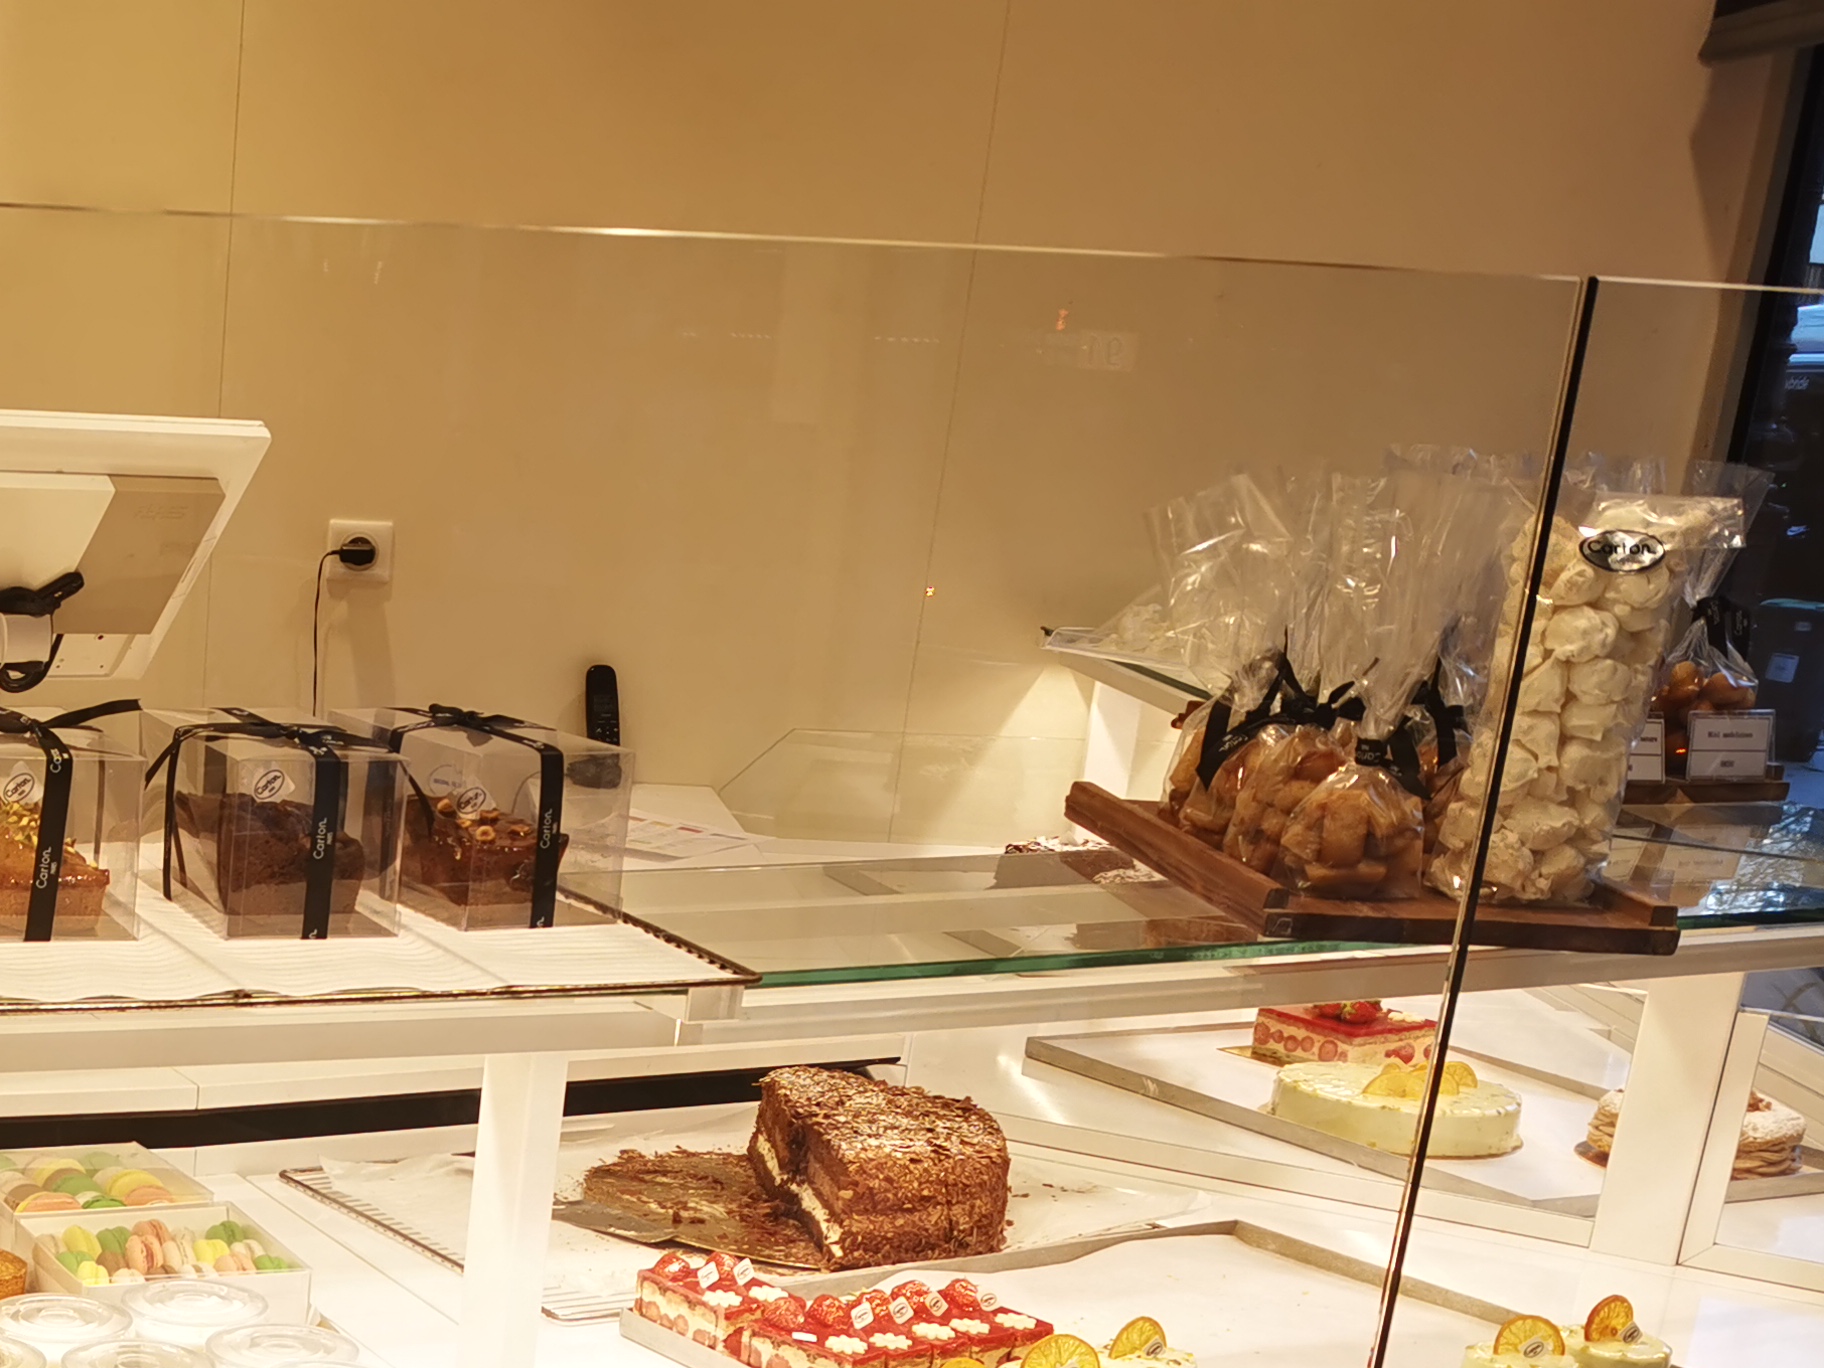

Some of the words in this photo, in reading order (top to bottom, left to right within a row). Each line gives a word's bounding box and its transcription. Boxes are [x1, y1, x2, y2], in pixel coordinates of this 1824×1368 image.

[1587, 540, 1657, 556] Carton
[5, 778, 33, 798] Carton
[312, 817, 328, 860] Carton
[539, 807, 553, 849] Carton
[35, 846, 52, 889] Carton
